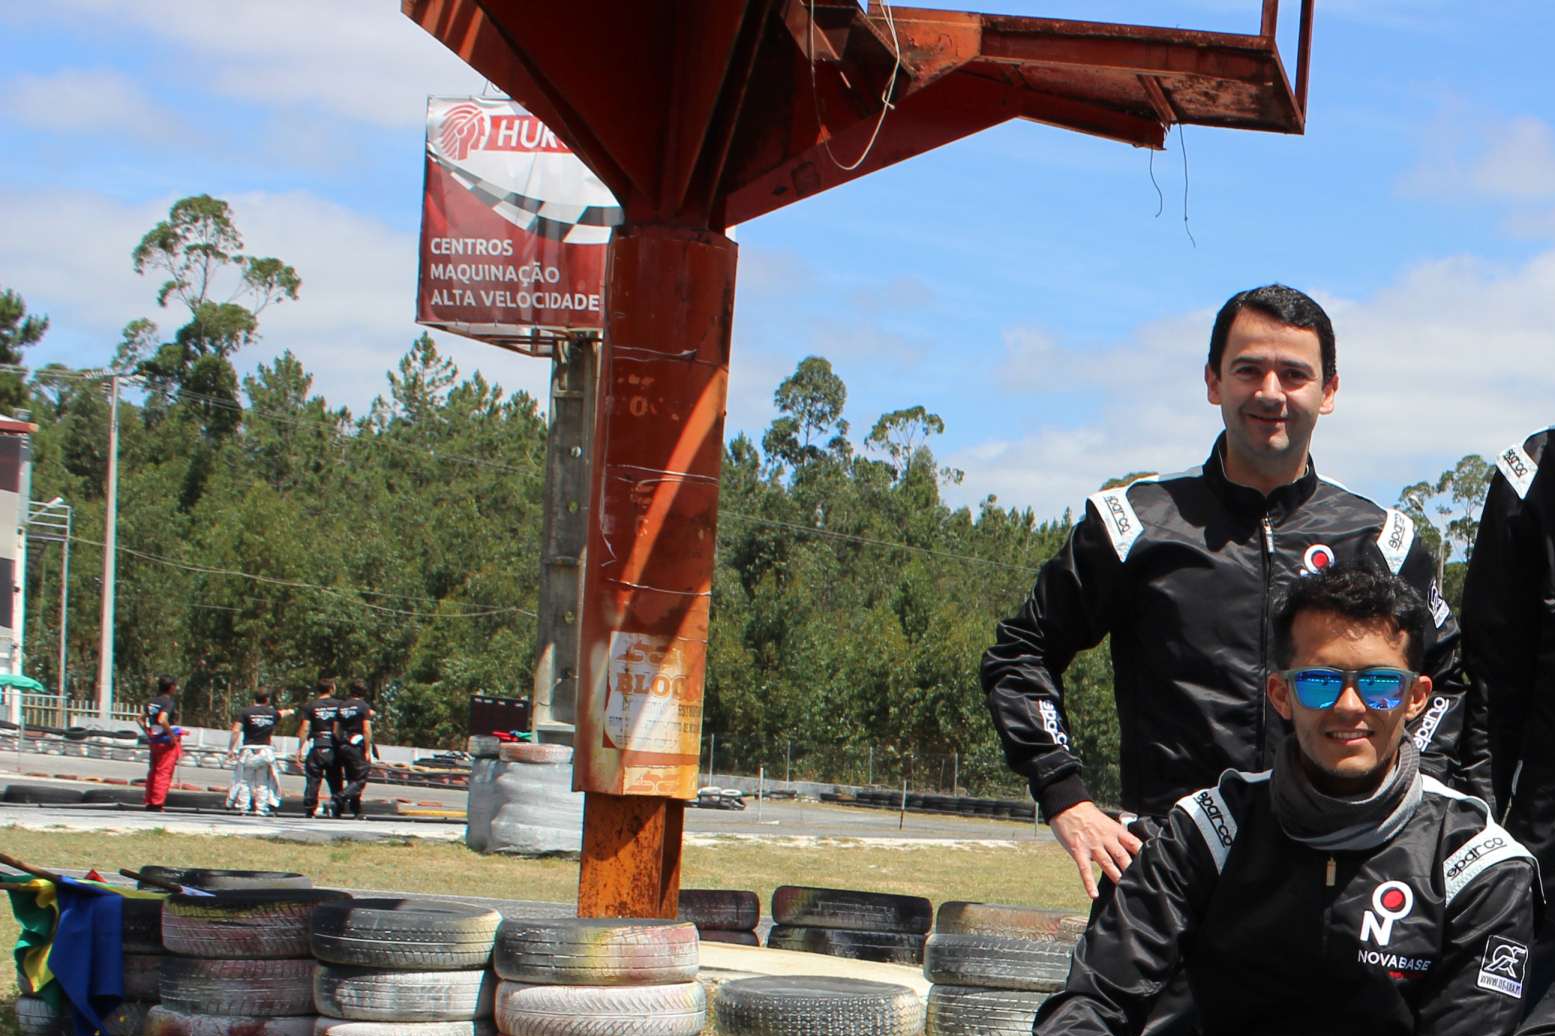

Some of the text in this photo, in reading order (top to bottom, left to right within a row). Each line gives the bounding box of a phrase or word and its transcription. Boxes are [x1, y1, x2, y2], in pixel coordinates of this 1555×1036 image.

[496, 118, 570, 149] HUR
[430, 237, 514, 257] CENTROS
[430, 262, 561, 287] MAQUINAÇÃO
[430, 289, 601, 312] ALTA VELOCIDADE
[1193, 791, 1233, 848] sparco
[1446, 836, 1508, 881] sparco
[1357, 950, 1432, 971] NOVABASE
